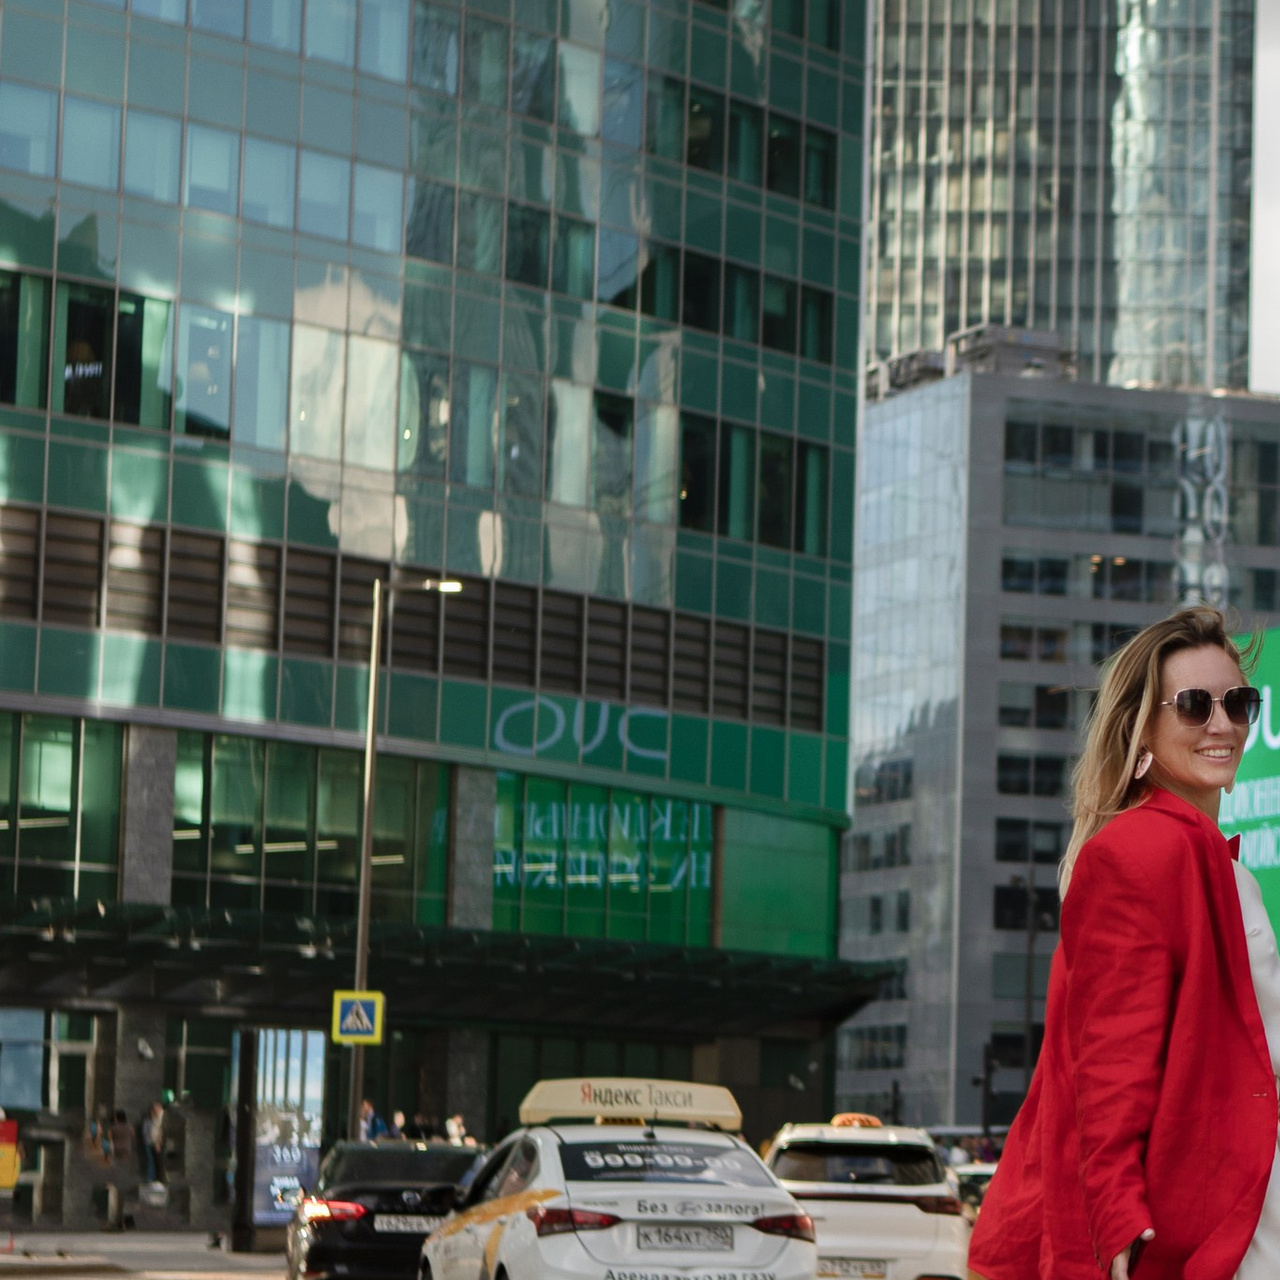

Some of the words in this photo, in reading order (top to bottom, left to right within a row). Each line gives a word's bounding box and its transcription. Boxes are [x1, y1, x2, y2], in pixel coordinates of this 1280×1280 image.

[580, 1082, 642, 1107] Яндекс
[646, 1083, 693, 1108] Такси
[637, 1199, 668, 1214] Без
